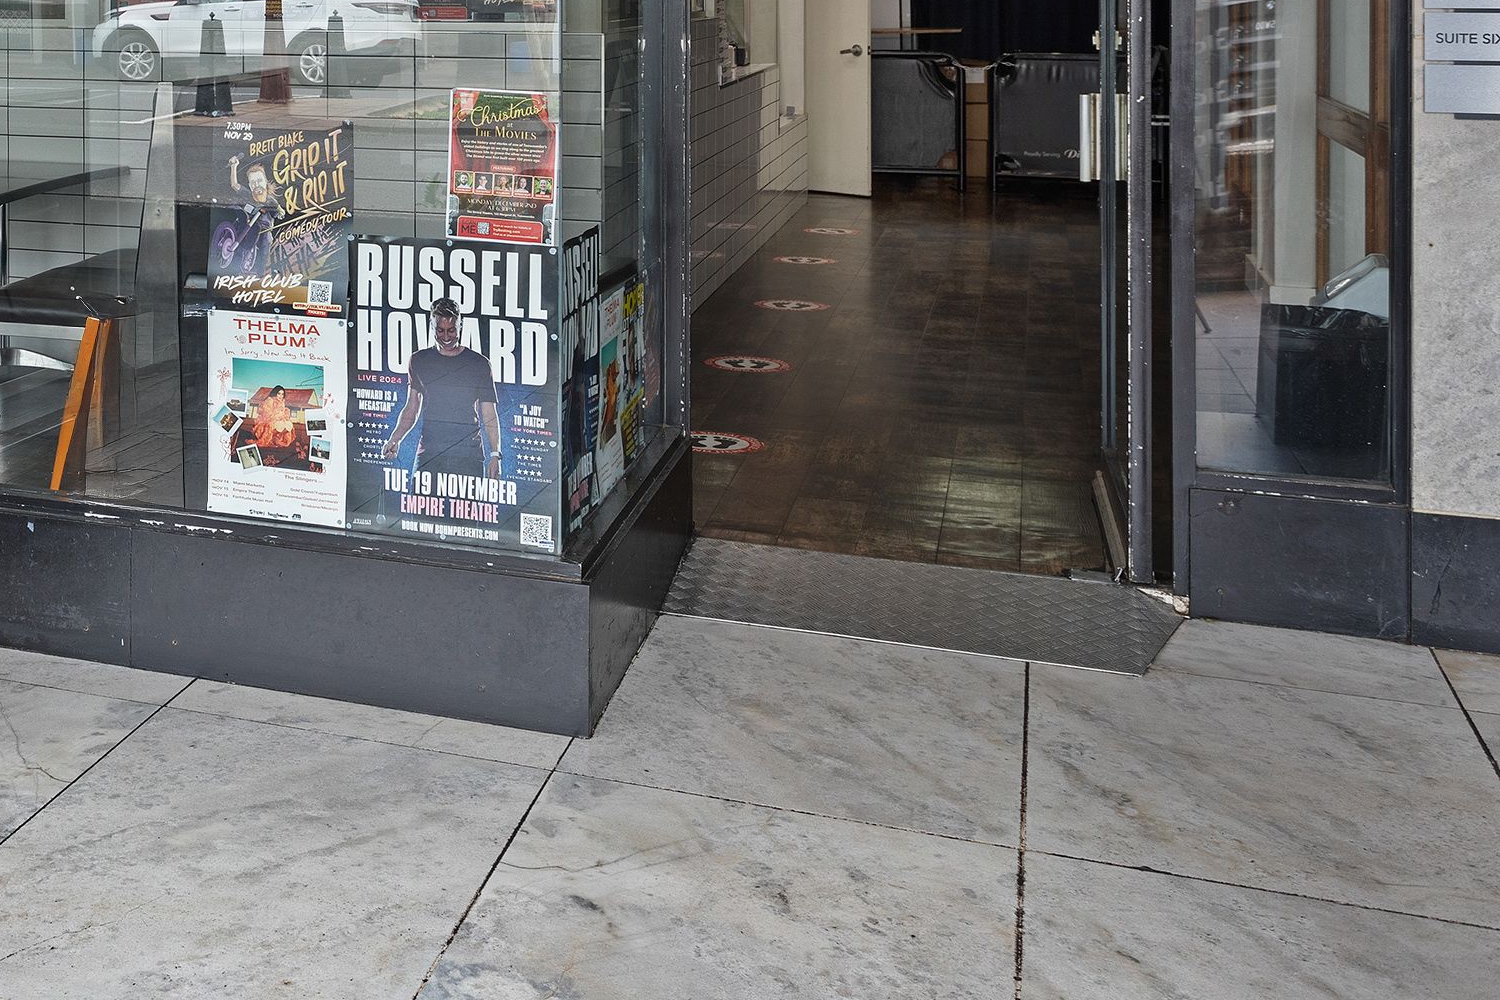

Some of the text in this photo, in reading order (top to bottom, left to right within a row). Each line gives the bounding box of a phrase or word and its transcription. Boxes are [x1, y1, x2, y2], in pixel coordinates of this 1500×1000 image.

[1435, 33, 1477, 44] SUITE
[457, 99, 543, 127] Christmas
[224, 131, 254, 141] NOV 29
[249, 131, 304, 157] BRETT BLAKE
[273, 128, 342, 186] GRIP IT
[284, 160, 347, 215] & RIP IT
[279, 207, 347, 243] COMEDY TOUR
[461, 225, 476, 234] ME
[213, 274, 260, 290] IRISH
[357, 242, 548, 320] RUSSELL
[232, 290, 285, 308] HOTEL
[233, 318, 321, 337] THELMA
[248, 333, 306, 348] PLUM
[284, 350, 297, 360] Say
[309, 353, 331, 363] Back
[358, 374, 402, 384] LIVE 2024
[385, 391, 392, 401] IS
[393, 392, 397, 401] A
[529, 405, 542, 416] JOY
[514, 415, 522, 425] TO
[383, 467, 517, 505] TUE 19 NOVEMBER
[401, 493, 498, 524] EMPIRE THEATRE
[402, 520, 418, 532] BOOK
[420, 523, 434, 533] NOW
